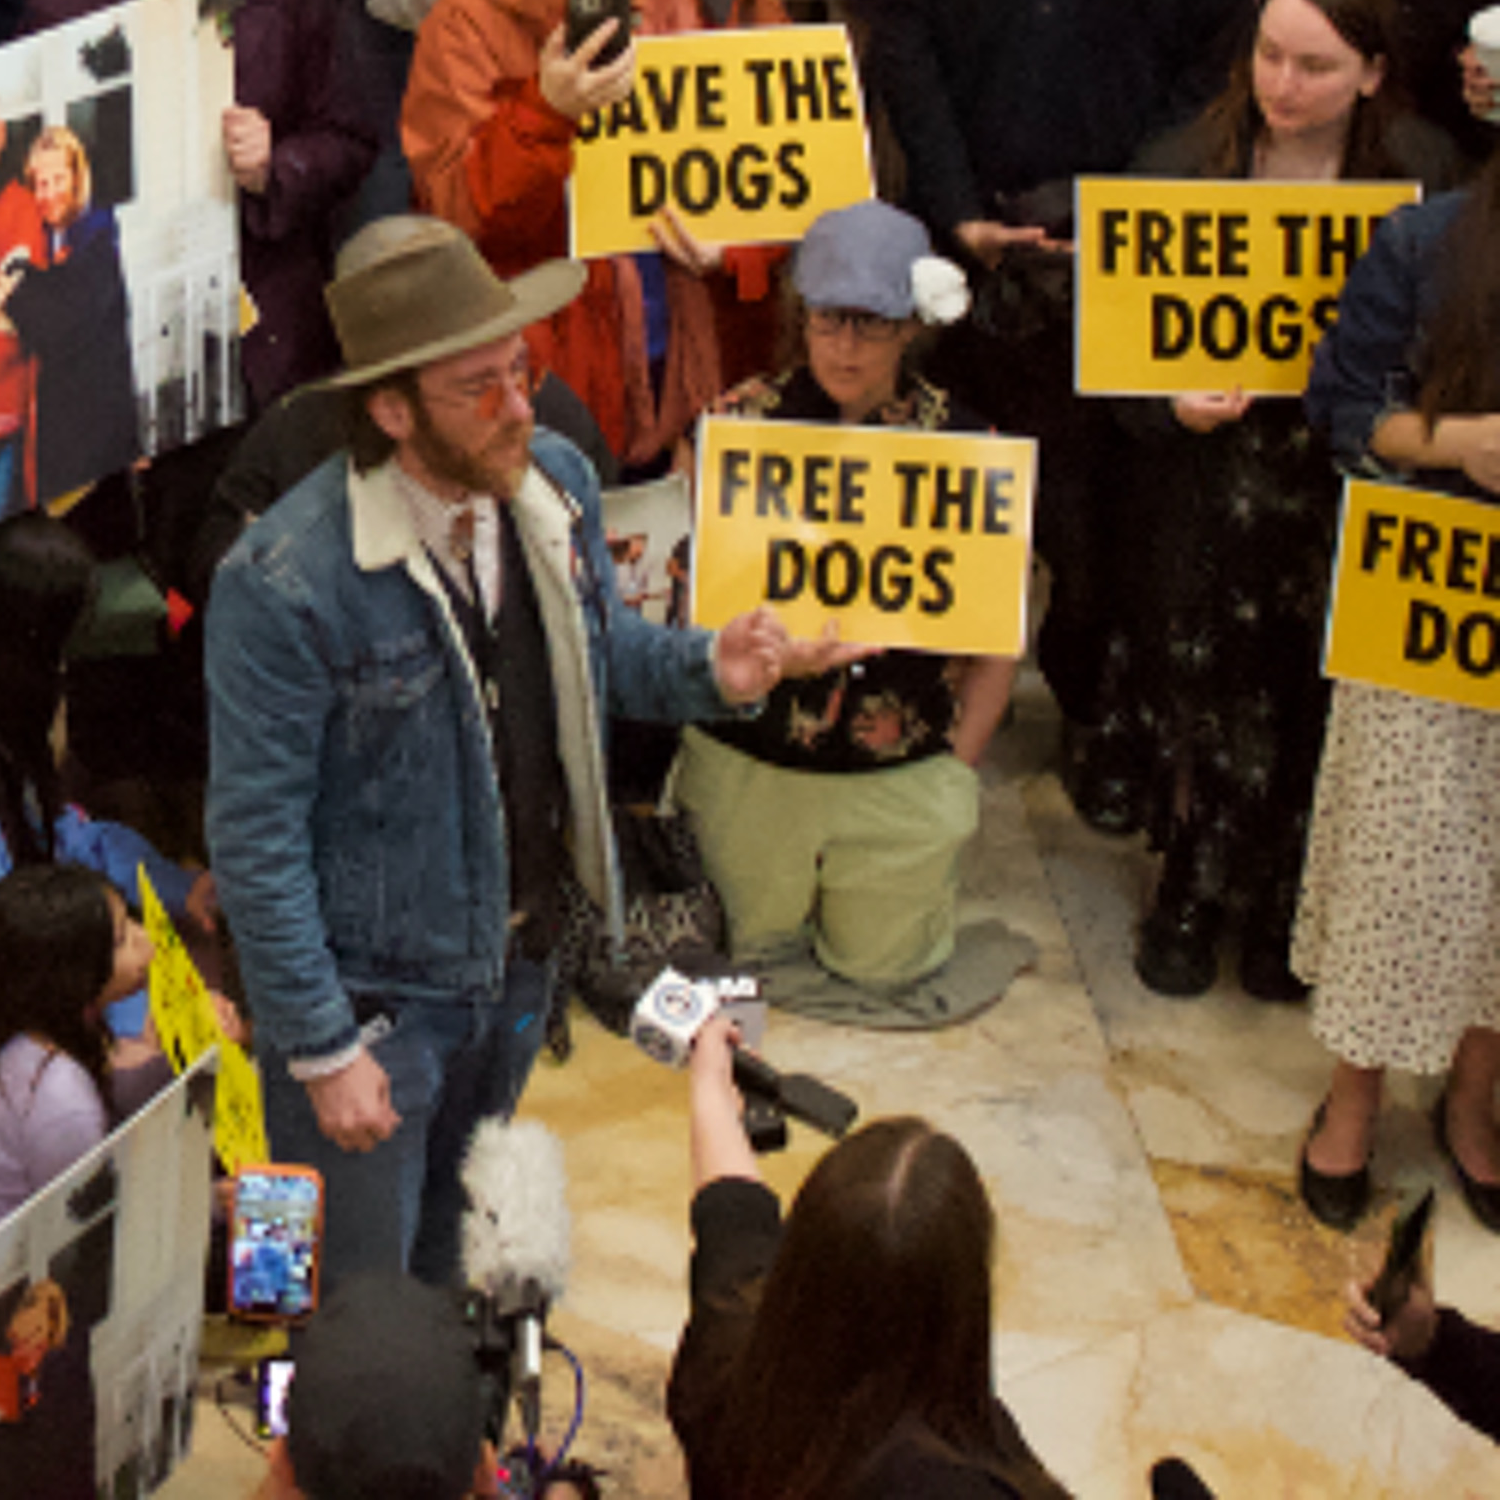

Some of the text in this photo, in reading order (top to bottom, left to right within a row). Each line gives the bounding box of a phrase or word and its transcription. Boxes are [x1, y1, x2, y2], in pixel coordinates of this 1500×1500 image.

[744, 55, 854, 126] THE
[629, 141, 811, 218] DOGS
[1099, 209, 1384, 278] FREE TH
[719, 449, 1016, 536] FREE THE
[765, 538, 956, 616] DOGS
